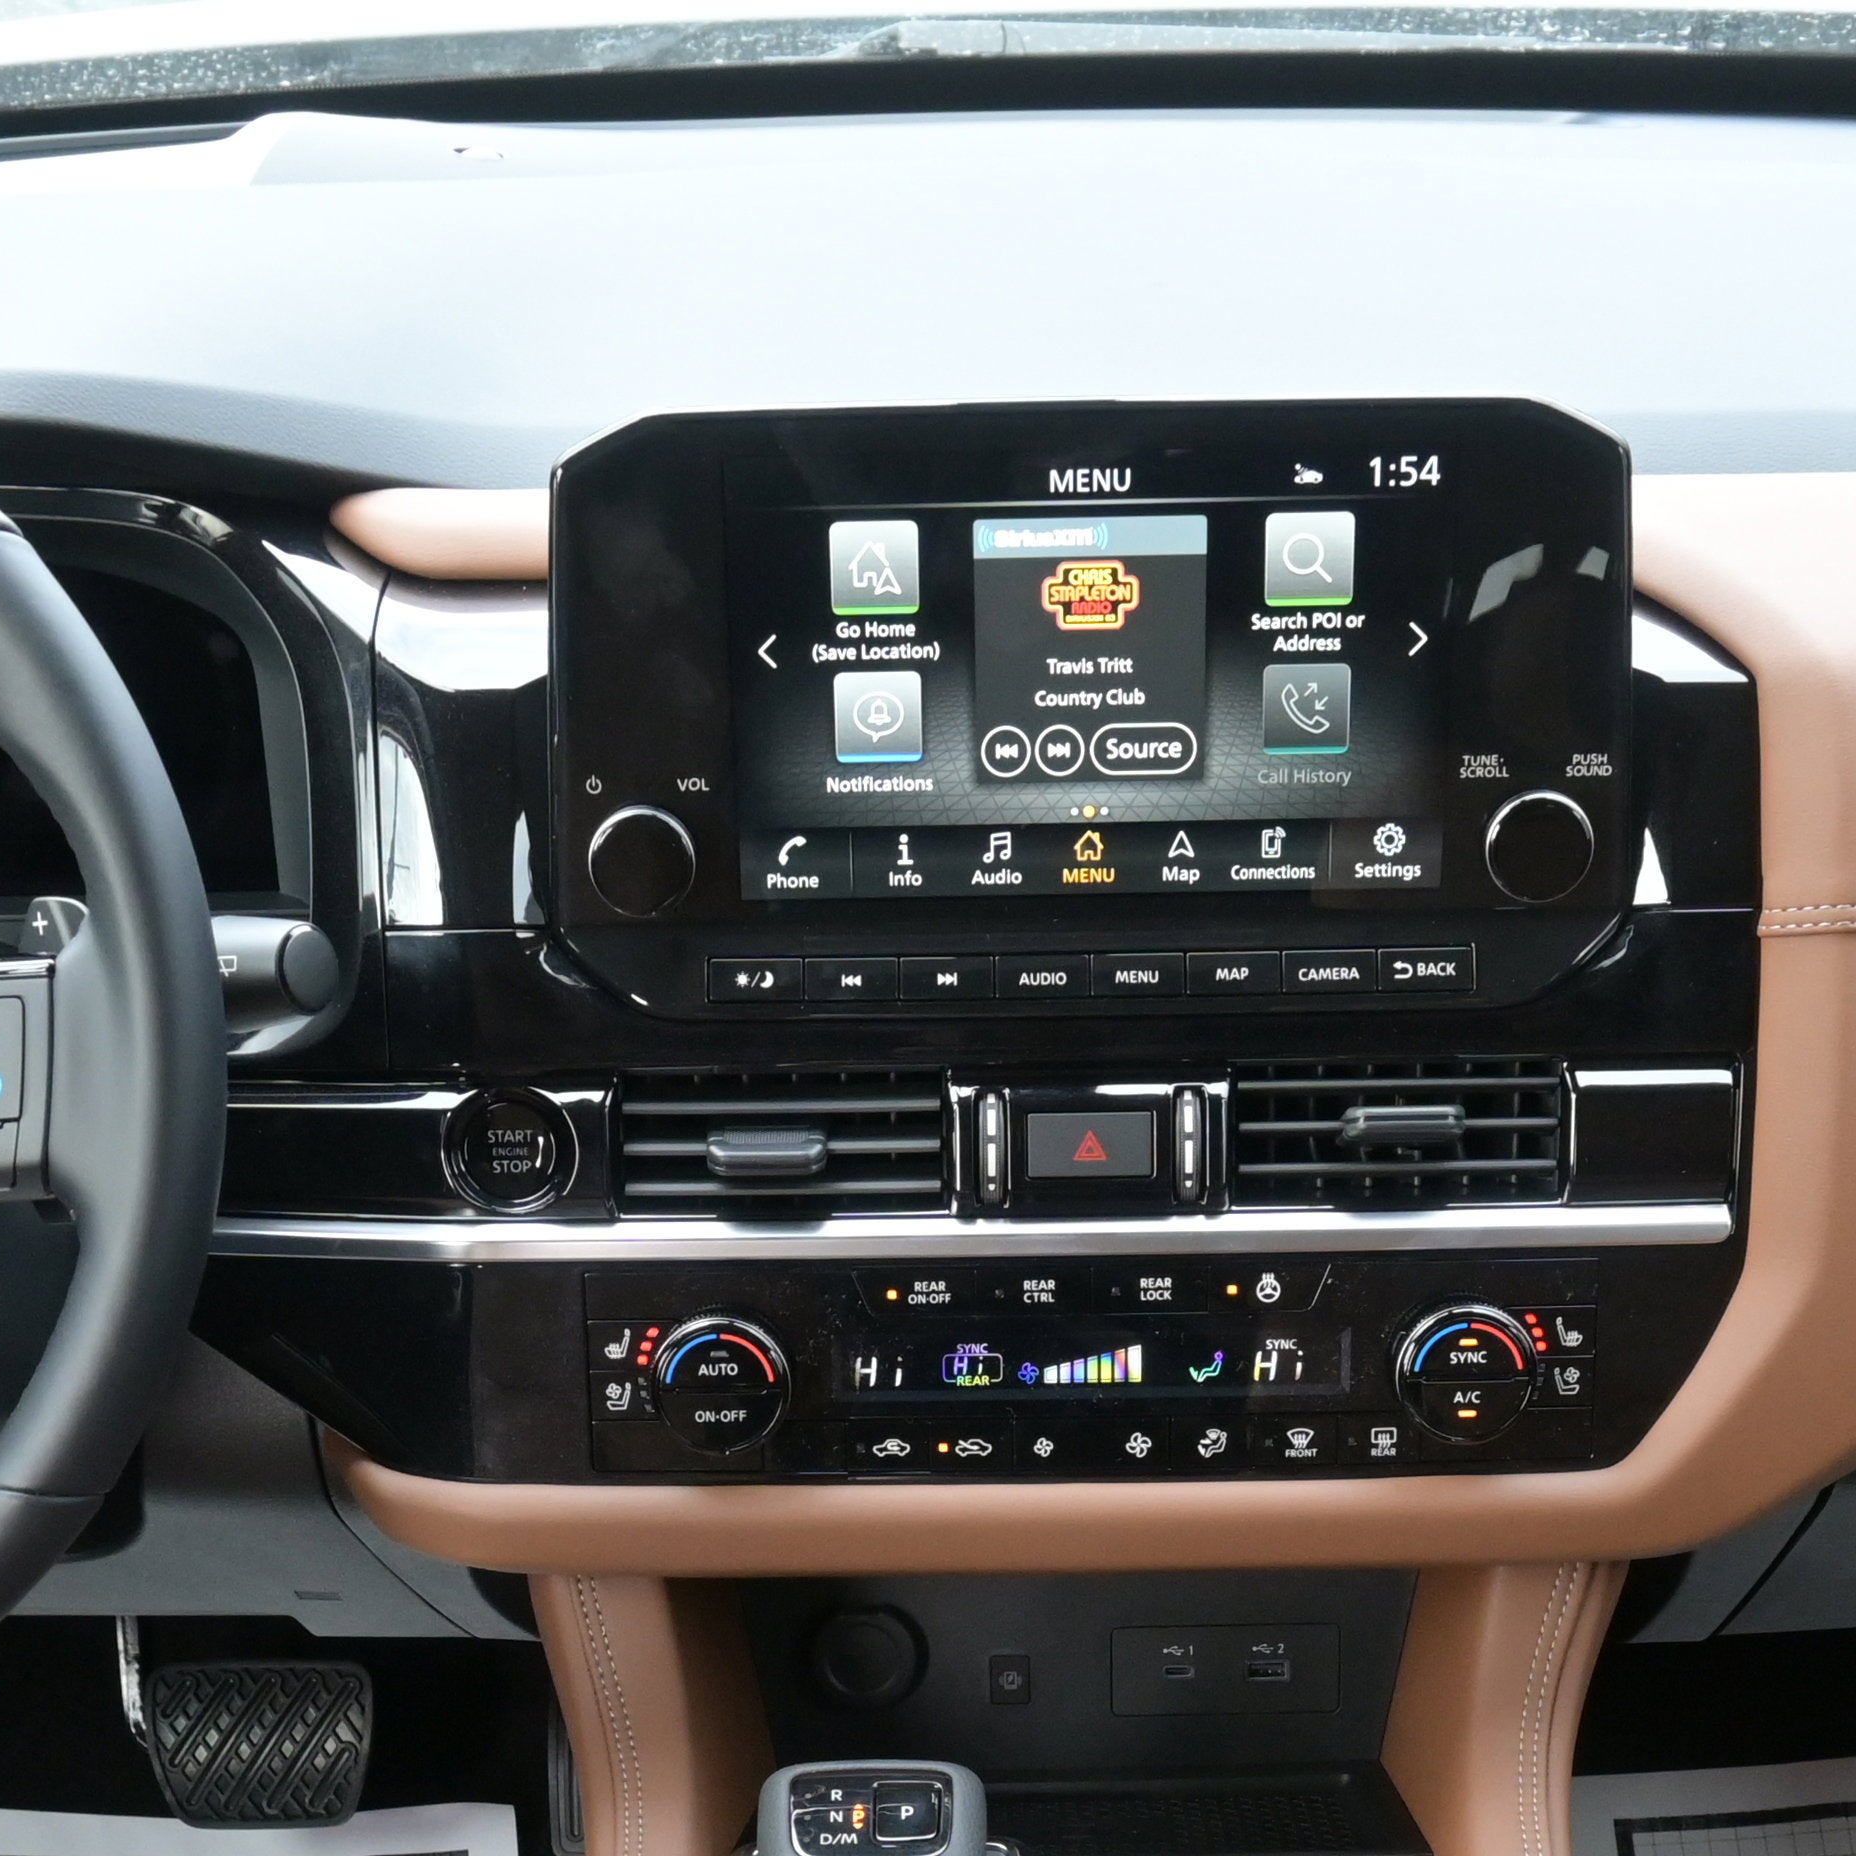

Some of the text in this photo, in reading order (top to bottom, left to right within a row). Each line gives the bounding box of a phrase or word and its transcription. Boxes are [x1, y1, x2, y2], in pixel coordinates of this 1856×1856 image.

[1369, 455, 1441, 487] 1:54
[1049, 467, 1132, 494] MENU
[1068, 568, 1113, 585] CHRIS
[1049, 584, 1131, 602] STAPLETON
[1251, 612, 1365, 630] Search POI or
[836, 621, 916, 638] Go Home
[1274, 635, 1341, 652] Address
[812, 640, 940, 663] (Save Location)
[1047, 657, 1133, 674] Travis Tritt
[1035, 688, 1145, 709] Country Club
[1105, 739, 1183, 760] Source
[1572, 753, 1607, 765] PUSH
[1258, 768, 1352, 786] Call History
[1460, 765, 1509, 778] SCROLL
[1566, 764, 1612, 777] SOUND
[677, 778, 709, 792] VOL
[827, 776, 933, 794] Notifications
[972, 868, 1022, 886] Audio
[1062, 867, 1115, 884] MENU
[1162, 865, 1200, 885] Map
[1231, 864, 1315, 881] Connections
[1354, 861, 1421, 880] Settings
[767, 872, 819, 889] Phone
[888, 870, 922, 887] Info
[1115, 969, 1159, 985] MENU
[1215, 966, 1249, 982] MAP
[1298, 966, 1360, 982] CAMERA
[1416, 961, 1456, 978] BACK
[1019, 972, 1067, 986] AUDIO
[487, 1130, 533, 1143] START
[492, 1147, 529, 1156] ENGINE
[493, 1160, 532, 1173] STOP
[914, 1281, 946, 1292] REAR
[1023, 1280, 1055, 1291] REAR
[1140, 1278, 1172, 1289] REAR
[1023, 1292, 1055, 1303] CTRL
[1140, 1289, 1172, 1301] LOCK
[956, 1343, 988, 1354] SYNC
[1265, 1338, 1298, 1351] SYNC
[1449, 1351, 1487, 1365] SYNC
[698, 1362, 738, 1377] AUTO
[956, 1375, 990, 1386] REAR
[1453, 1390, 1481, 1405] A/C
[1285, 1448, 1317, 1458] FRONT
[1370, 1446, 1397, 1457] REAR
[831, 1789, 843, 1801] R
[830, 1811, 843, 1823] N
[901, 1806, 914, 1820] P
[820, 1833, 858, 1845] D/M
